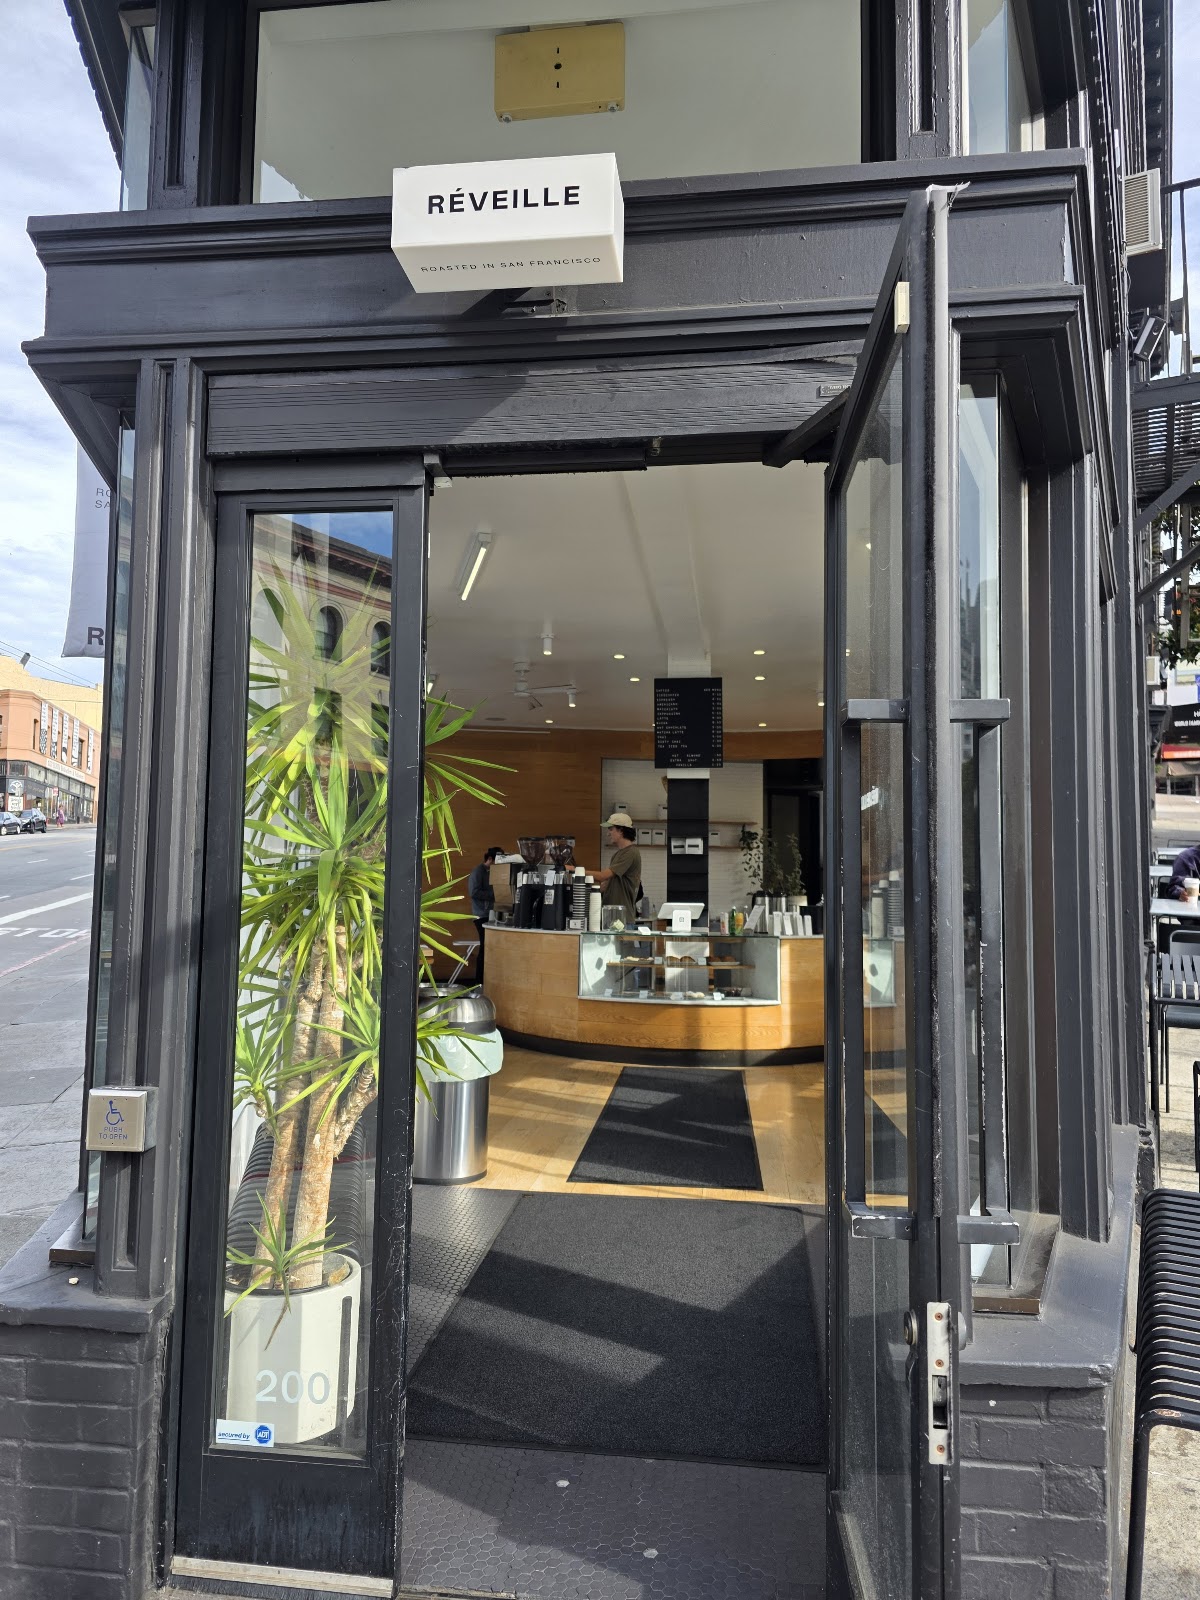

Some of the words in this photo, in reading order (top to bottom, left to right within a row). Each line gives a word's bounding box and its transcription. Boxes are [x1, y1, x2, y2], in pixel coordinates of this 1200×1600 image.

[428, 185, 580, 215] RÉVEILLE
[420, 264, 477, 273] ROASTED
[529, 257, 601, 267] FRANCISCO
[255, 1369, 331, 1405] 200
